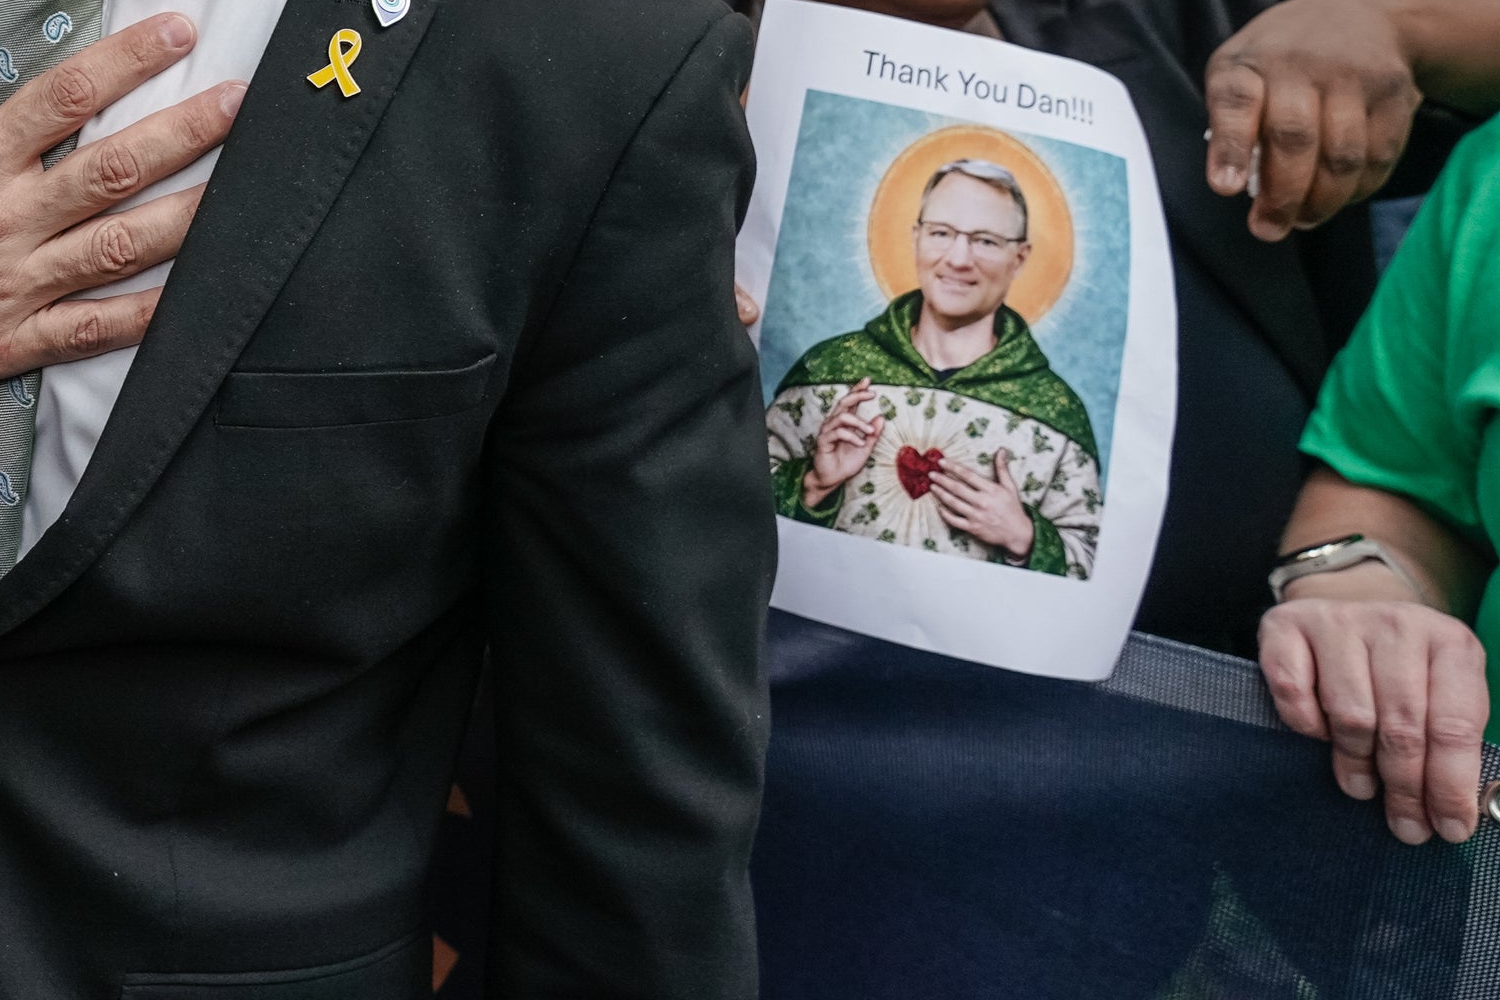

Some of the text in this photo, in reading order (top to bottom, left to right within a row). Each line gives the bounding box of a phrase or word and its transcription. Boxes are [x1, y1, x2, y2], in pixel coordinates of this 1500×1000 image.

[863, 49, 1094, 126] Thank You Dan!!!
